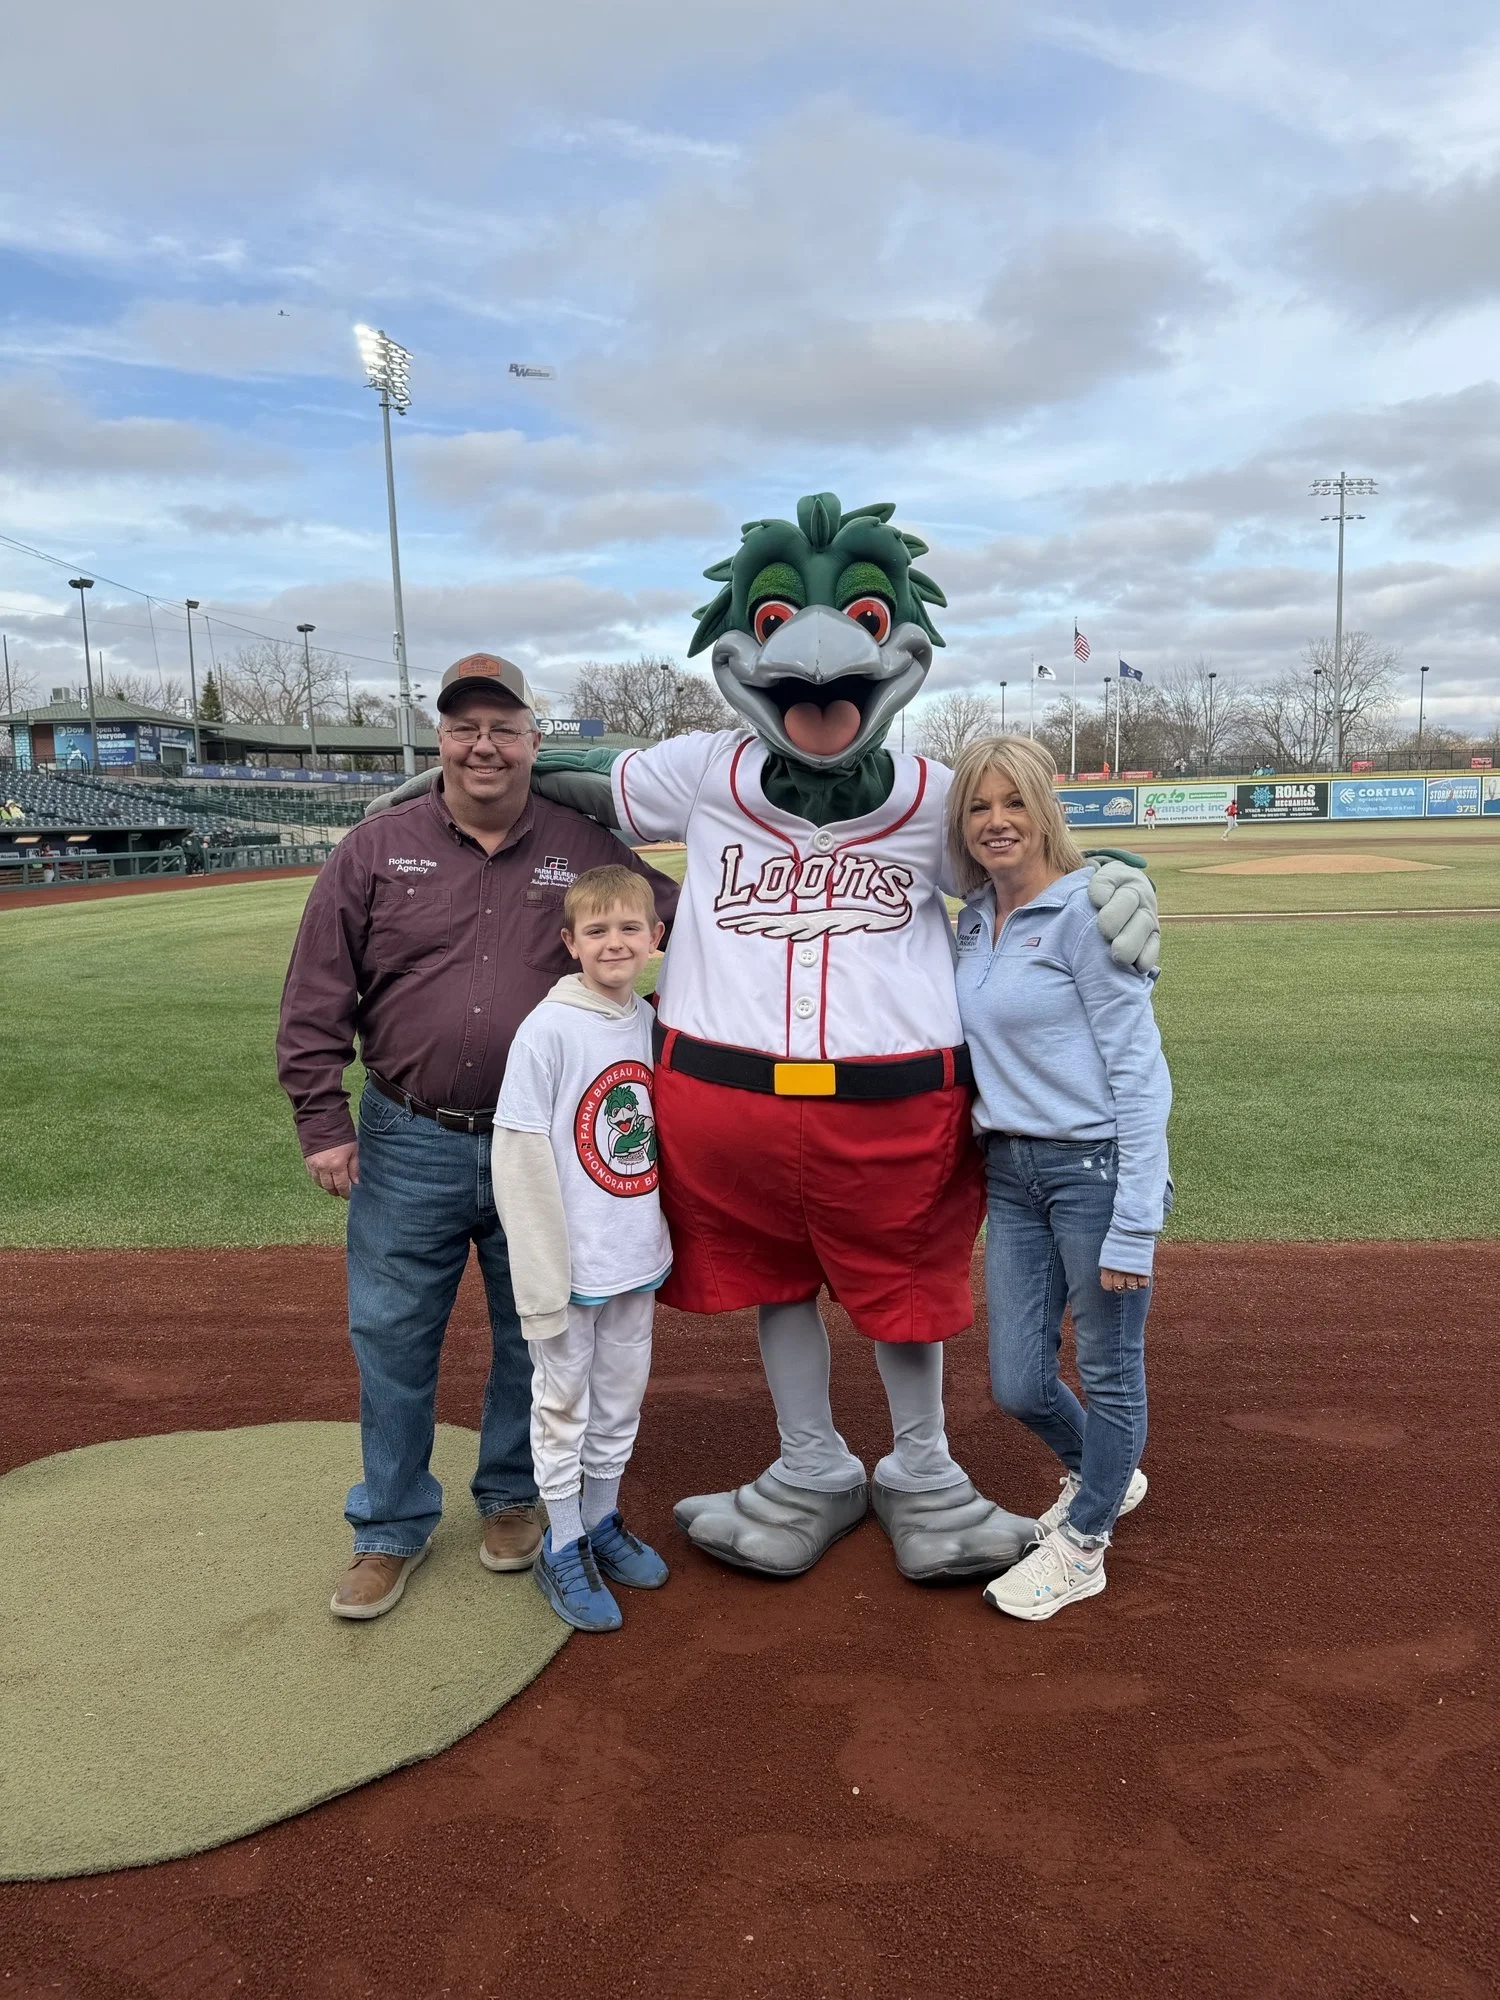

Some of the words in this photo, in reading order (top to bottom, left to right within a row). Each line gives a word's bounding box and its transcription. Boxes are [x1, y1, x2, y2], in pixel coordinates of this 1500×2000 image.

[553, 721, 581, 731] Dow
[1275, 785, 1316, 799] ROLLS
[1358, 788, 1415, 797] CORTEVA
[1453, 789, 1478, 799] MASTER
[1275, 799, 1316, 807] MECHANICAL
[1156, 803, 1204, 814] ransport
[1456, 805, 1477, 813] 375
[388, 858, 417, 866] Robert
[420, 859, 437, 868] Pike
[396, 865, 428, 874] Agency
[554, 870, 578, 879] BUREAU
[539, 874, 574, 883] INSURANCE
[713, 843, 914, 912] Loons
[581, 1101, 596, 1140] FARM
[594, 1067, 633, 1098] BUREAU
[637, 1068, 653, 1090] INSU
[585, 1150, 640, 1191] HONORARY
[644, 1172, 658, 1187] BA
